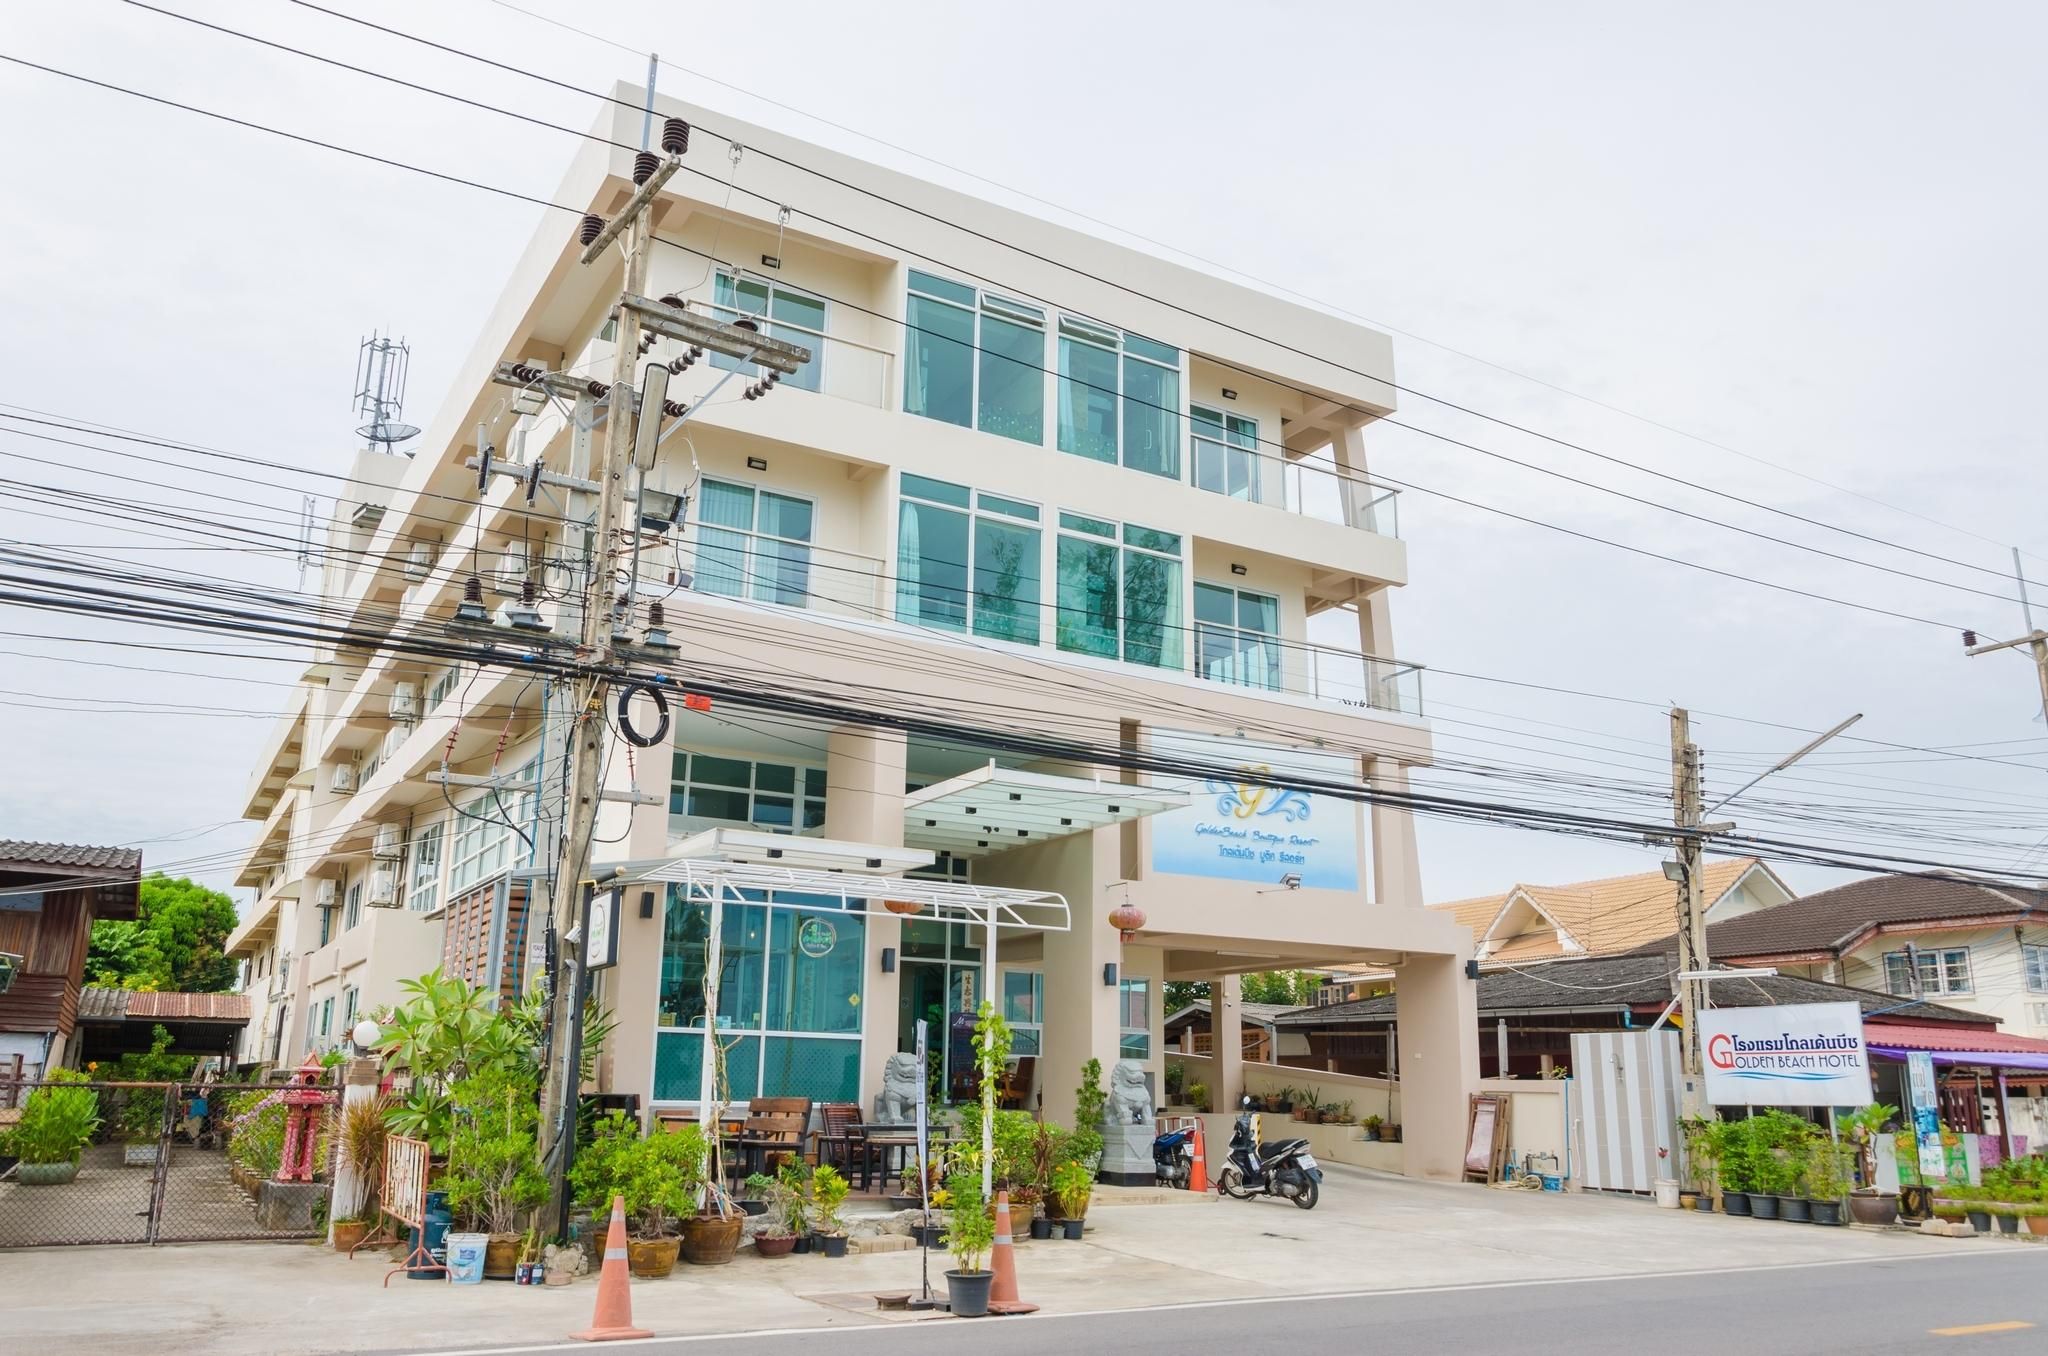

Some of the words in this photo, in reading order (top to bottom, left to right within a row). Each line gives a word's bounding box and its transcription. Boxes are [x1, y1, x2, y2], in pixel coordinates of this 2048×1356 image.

[1252, 830, 1285, 845] Boutique
[1289, 835, 1320, 846] Resort
[1708, 1033, 1775, 1069] GOLDEN
[1778, 1055, 1815, 1068] BEACH
[1818, 1054, 1861, 1068] HOTEL
[1731, 1033, 1858, 1052] โรงแรมโกลเด้นบีช
